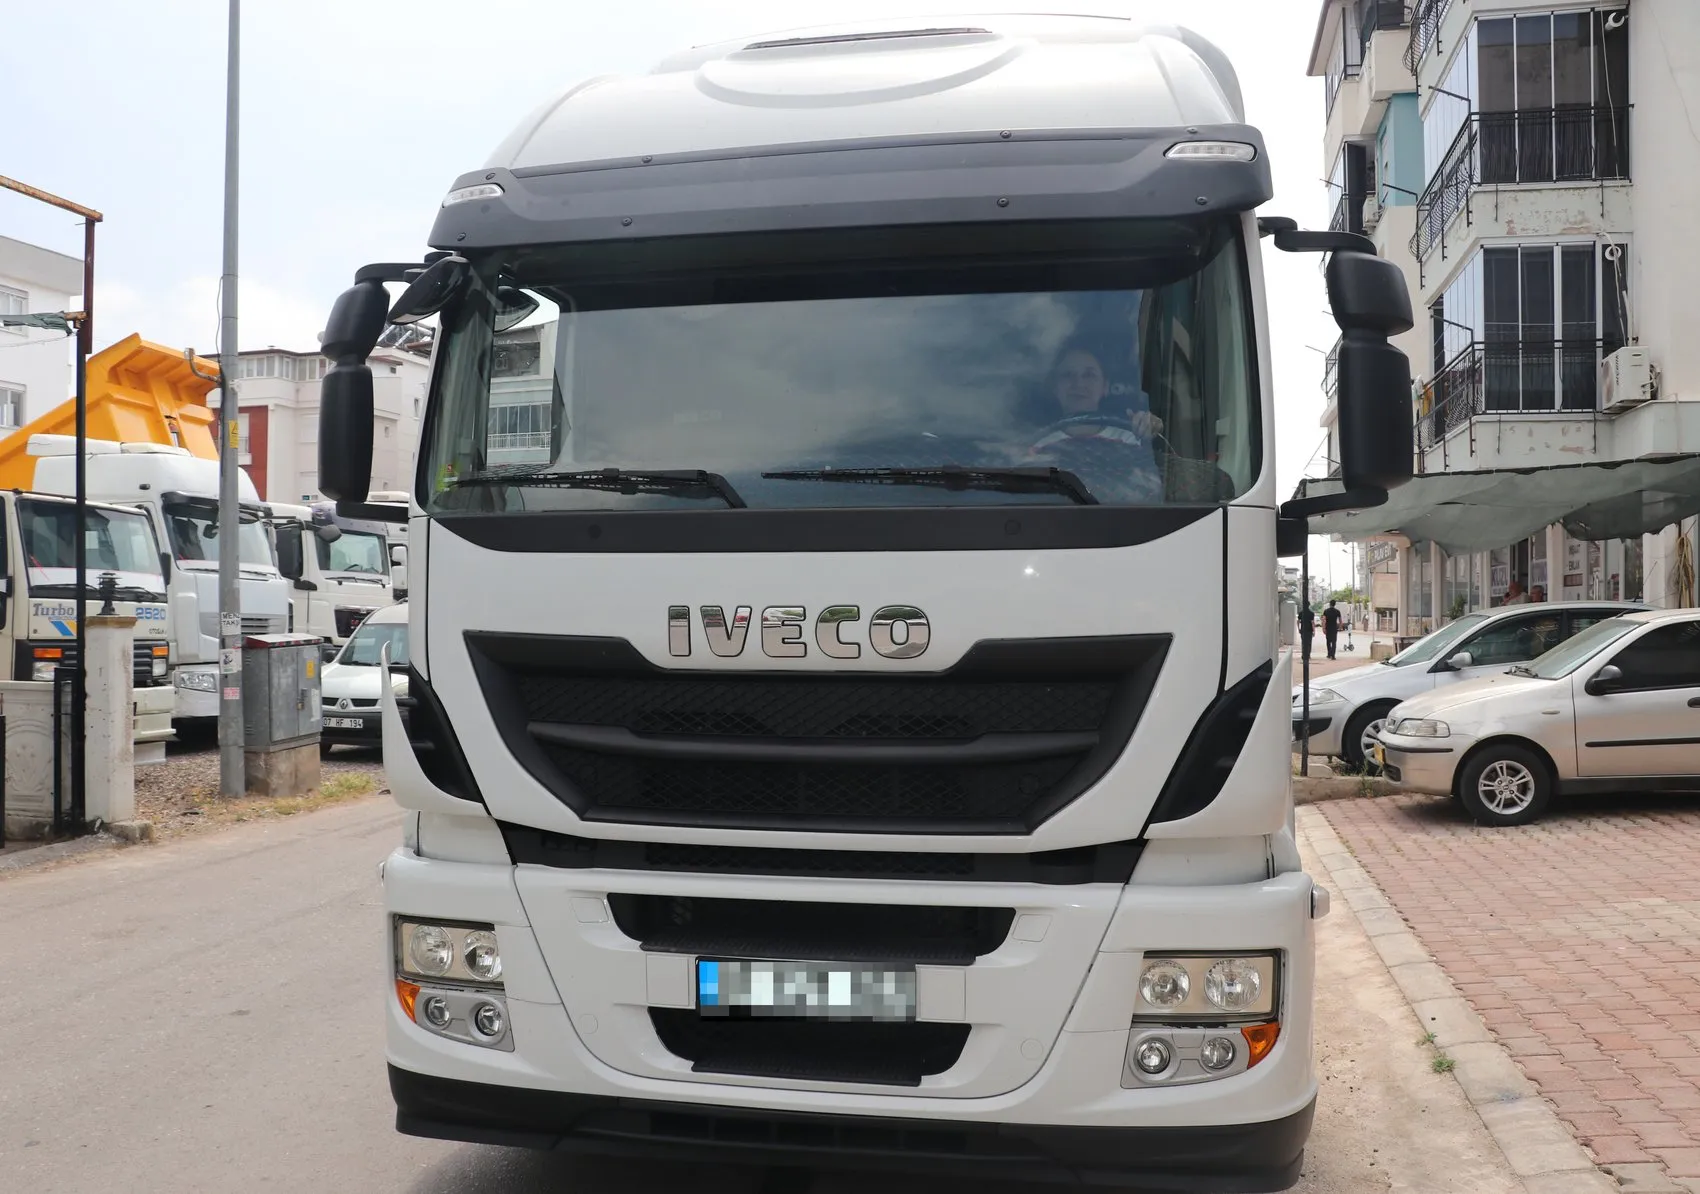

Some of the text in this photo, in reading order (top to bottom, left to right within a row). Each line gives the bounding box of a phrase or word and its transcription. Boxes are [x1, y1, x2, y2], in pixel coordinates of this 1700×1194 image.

[33, 603, 75, 616] Turbo
[135, 607, 167, 620] 2520
[668, 605, 931, 659] IVECO
[323, 717, 331, 726] 07
